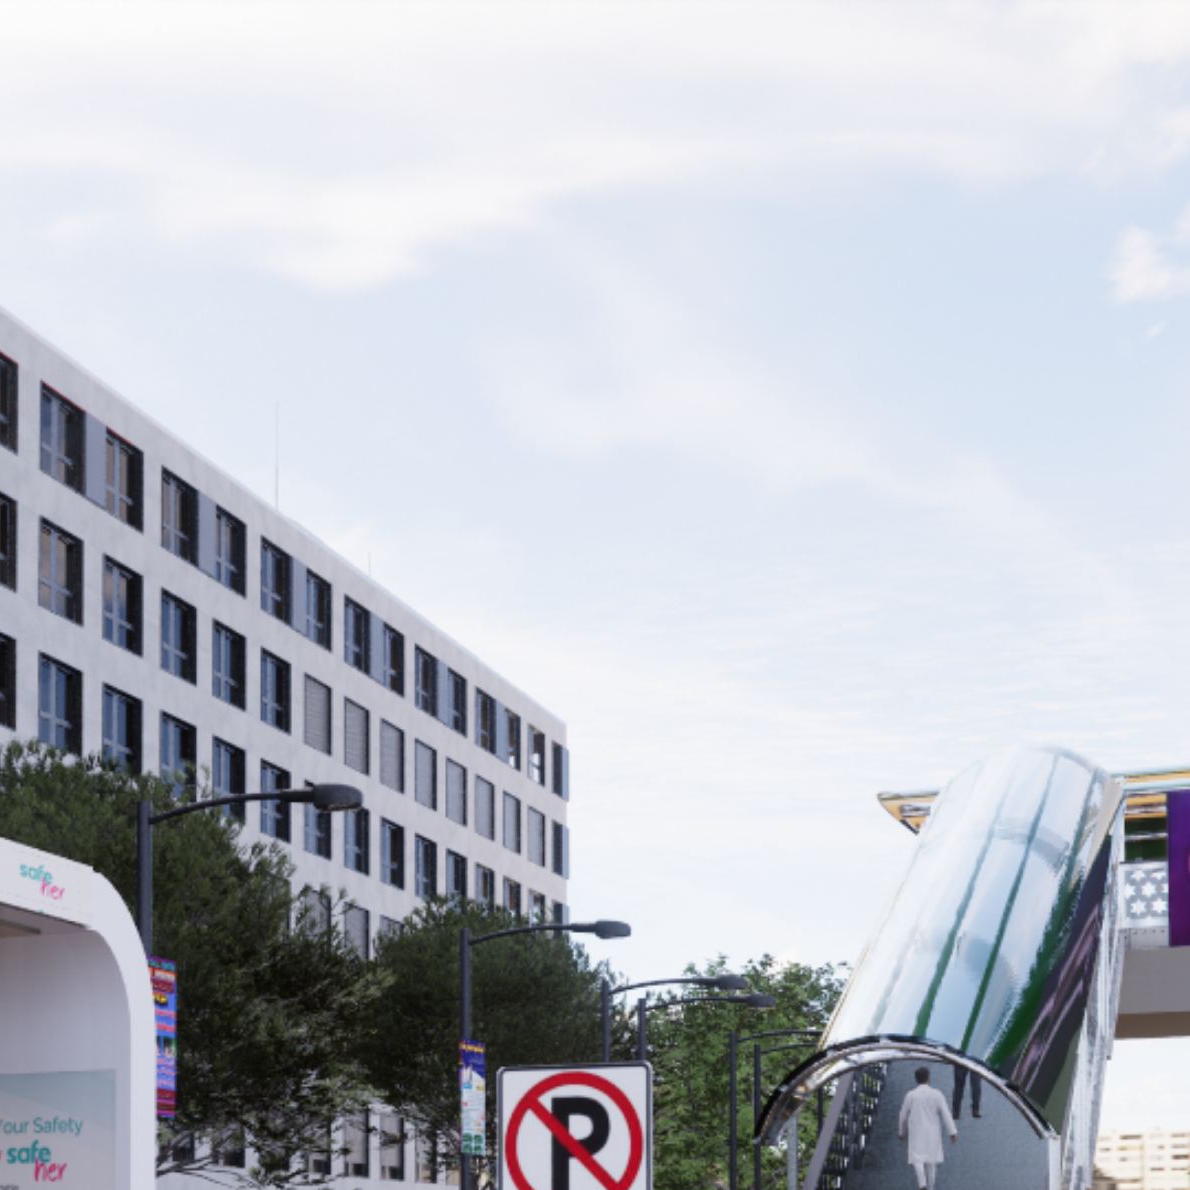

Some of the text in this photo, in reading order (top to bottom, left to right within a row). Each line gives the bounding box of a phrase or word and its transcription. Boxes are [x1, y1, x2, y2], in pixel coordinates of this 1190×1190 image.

[20, 864, 53, 884] safe
[39, 877, 66, 900] her
[33, 1116, 84, 1137] Safety
[7, 1139, 51, 1164] safe
[34, 1157, 67, 1182] her
